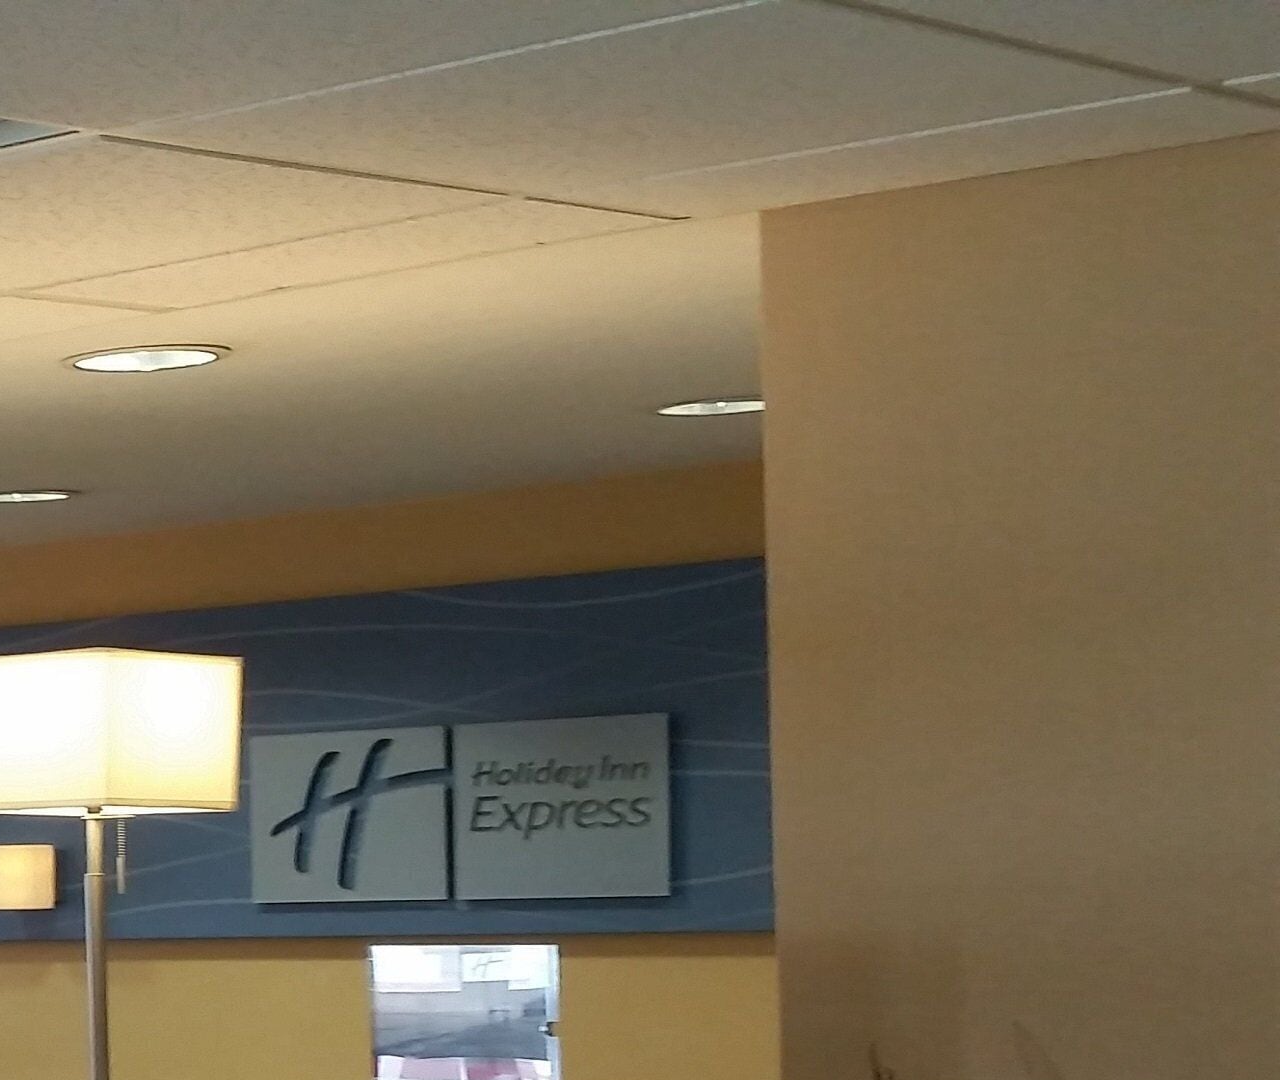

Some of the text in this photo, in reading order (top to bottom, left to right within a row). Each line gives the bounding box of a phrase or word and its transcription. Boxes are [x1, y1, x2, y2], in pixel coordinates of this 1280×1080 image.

[471, 754, 651, 789] Holiday Inn
[469, 796, 651, 840] Express
